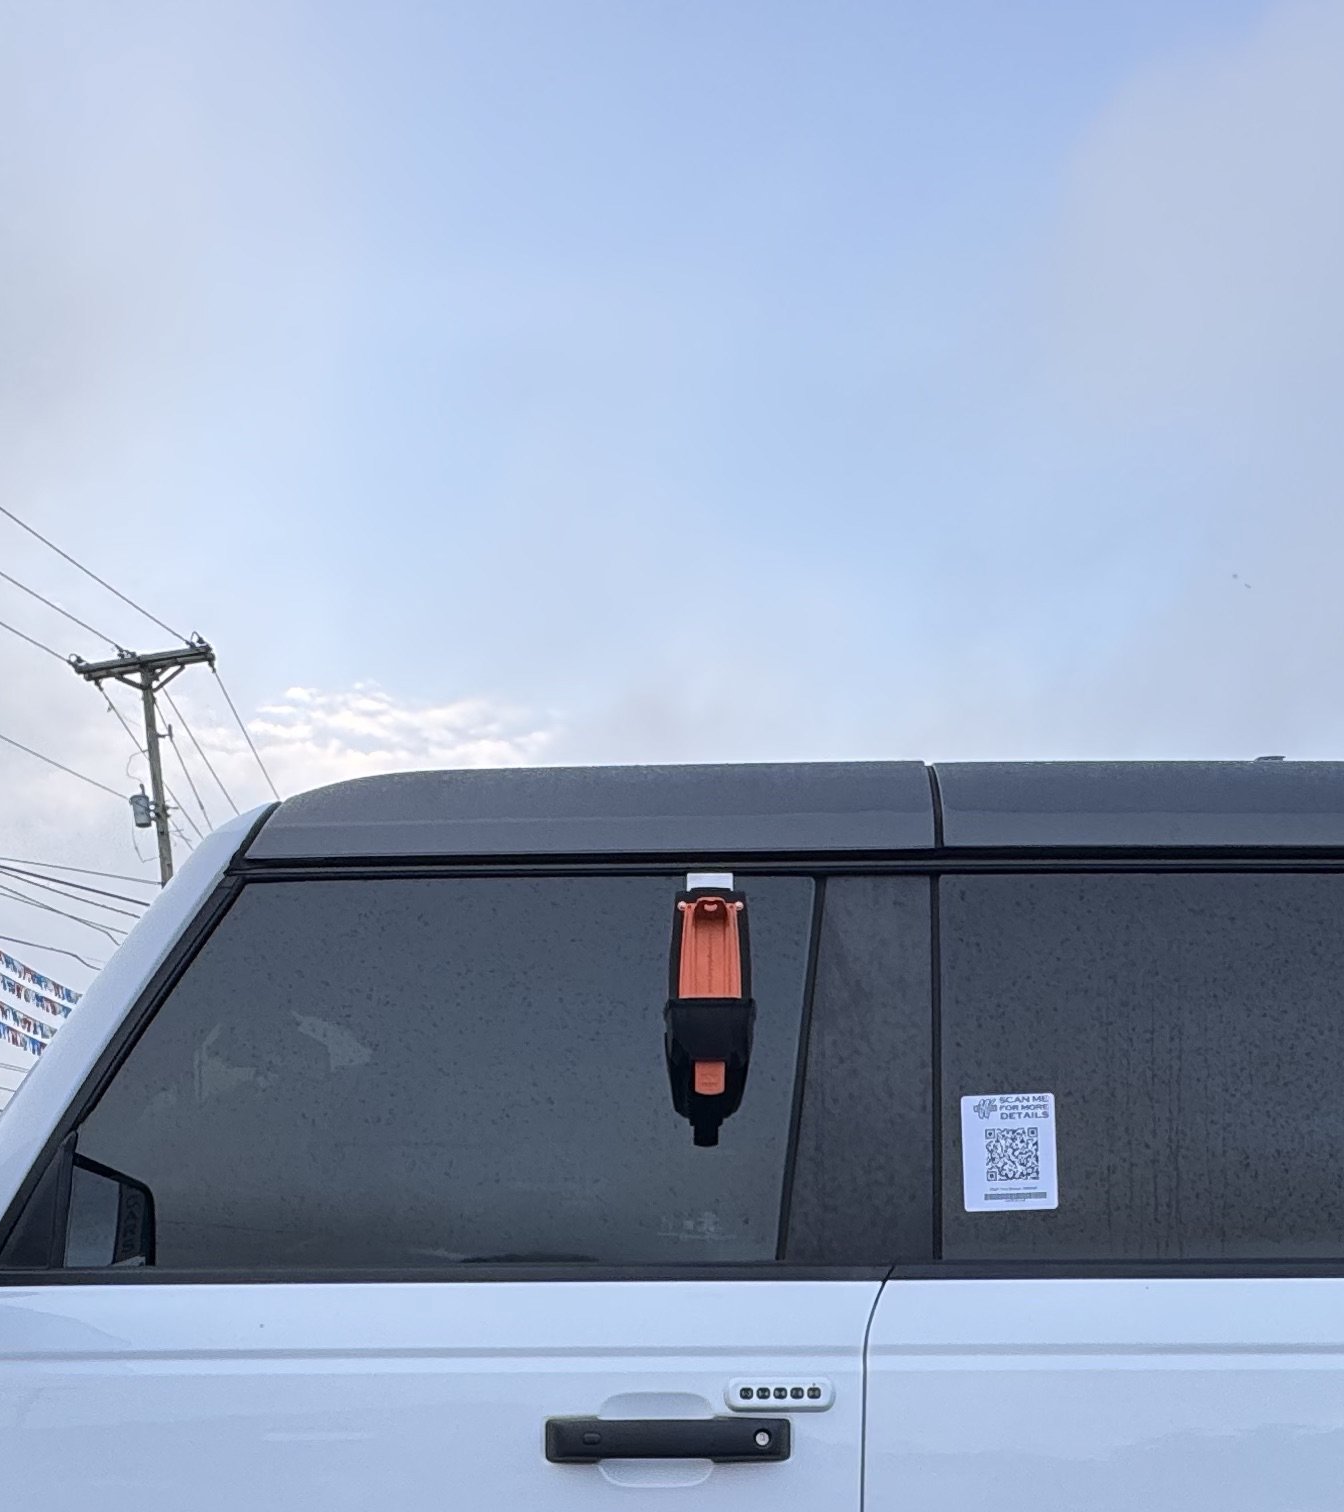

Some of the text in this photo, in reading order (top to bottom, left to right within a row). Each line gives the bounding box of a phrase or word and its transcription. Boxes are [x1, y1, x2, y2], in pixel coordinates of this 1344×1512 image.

[999, 1095, 1049, 1104] SCAN ME
[1000, 1112, 1050, 1120] DETAILS
